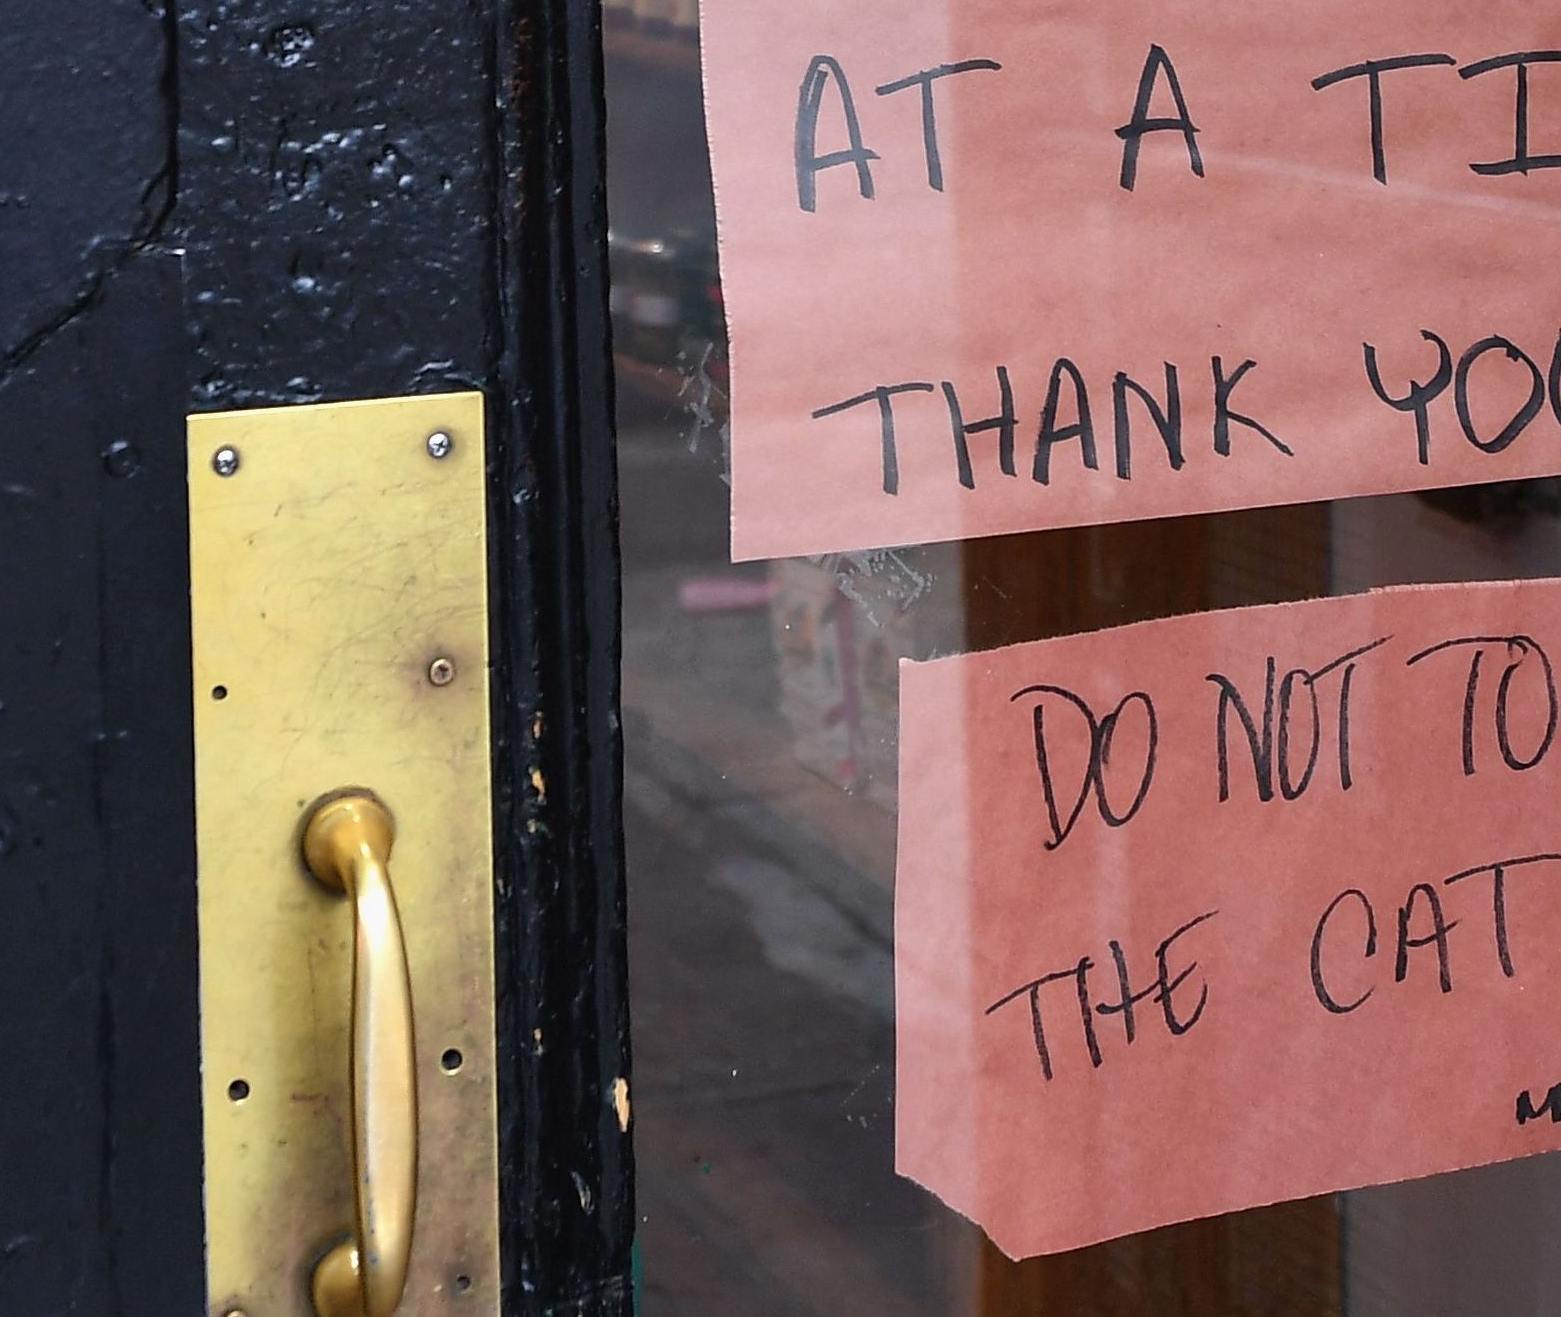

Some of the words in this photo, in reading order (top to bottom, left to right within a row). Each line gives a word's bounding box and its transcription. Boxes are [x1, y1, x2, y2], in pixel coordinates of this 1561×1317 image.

[797, 55, 1001, 213] AT
[1115, 44, 1205, 191] A
[813, 356, 1295, 497] THANK
[1011, 685, 1157, 851] DO
[1206, 636, 1394, 802] NOT
[986, 911, 1219, 1080] THE
